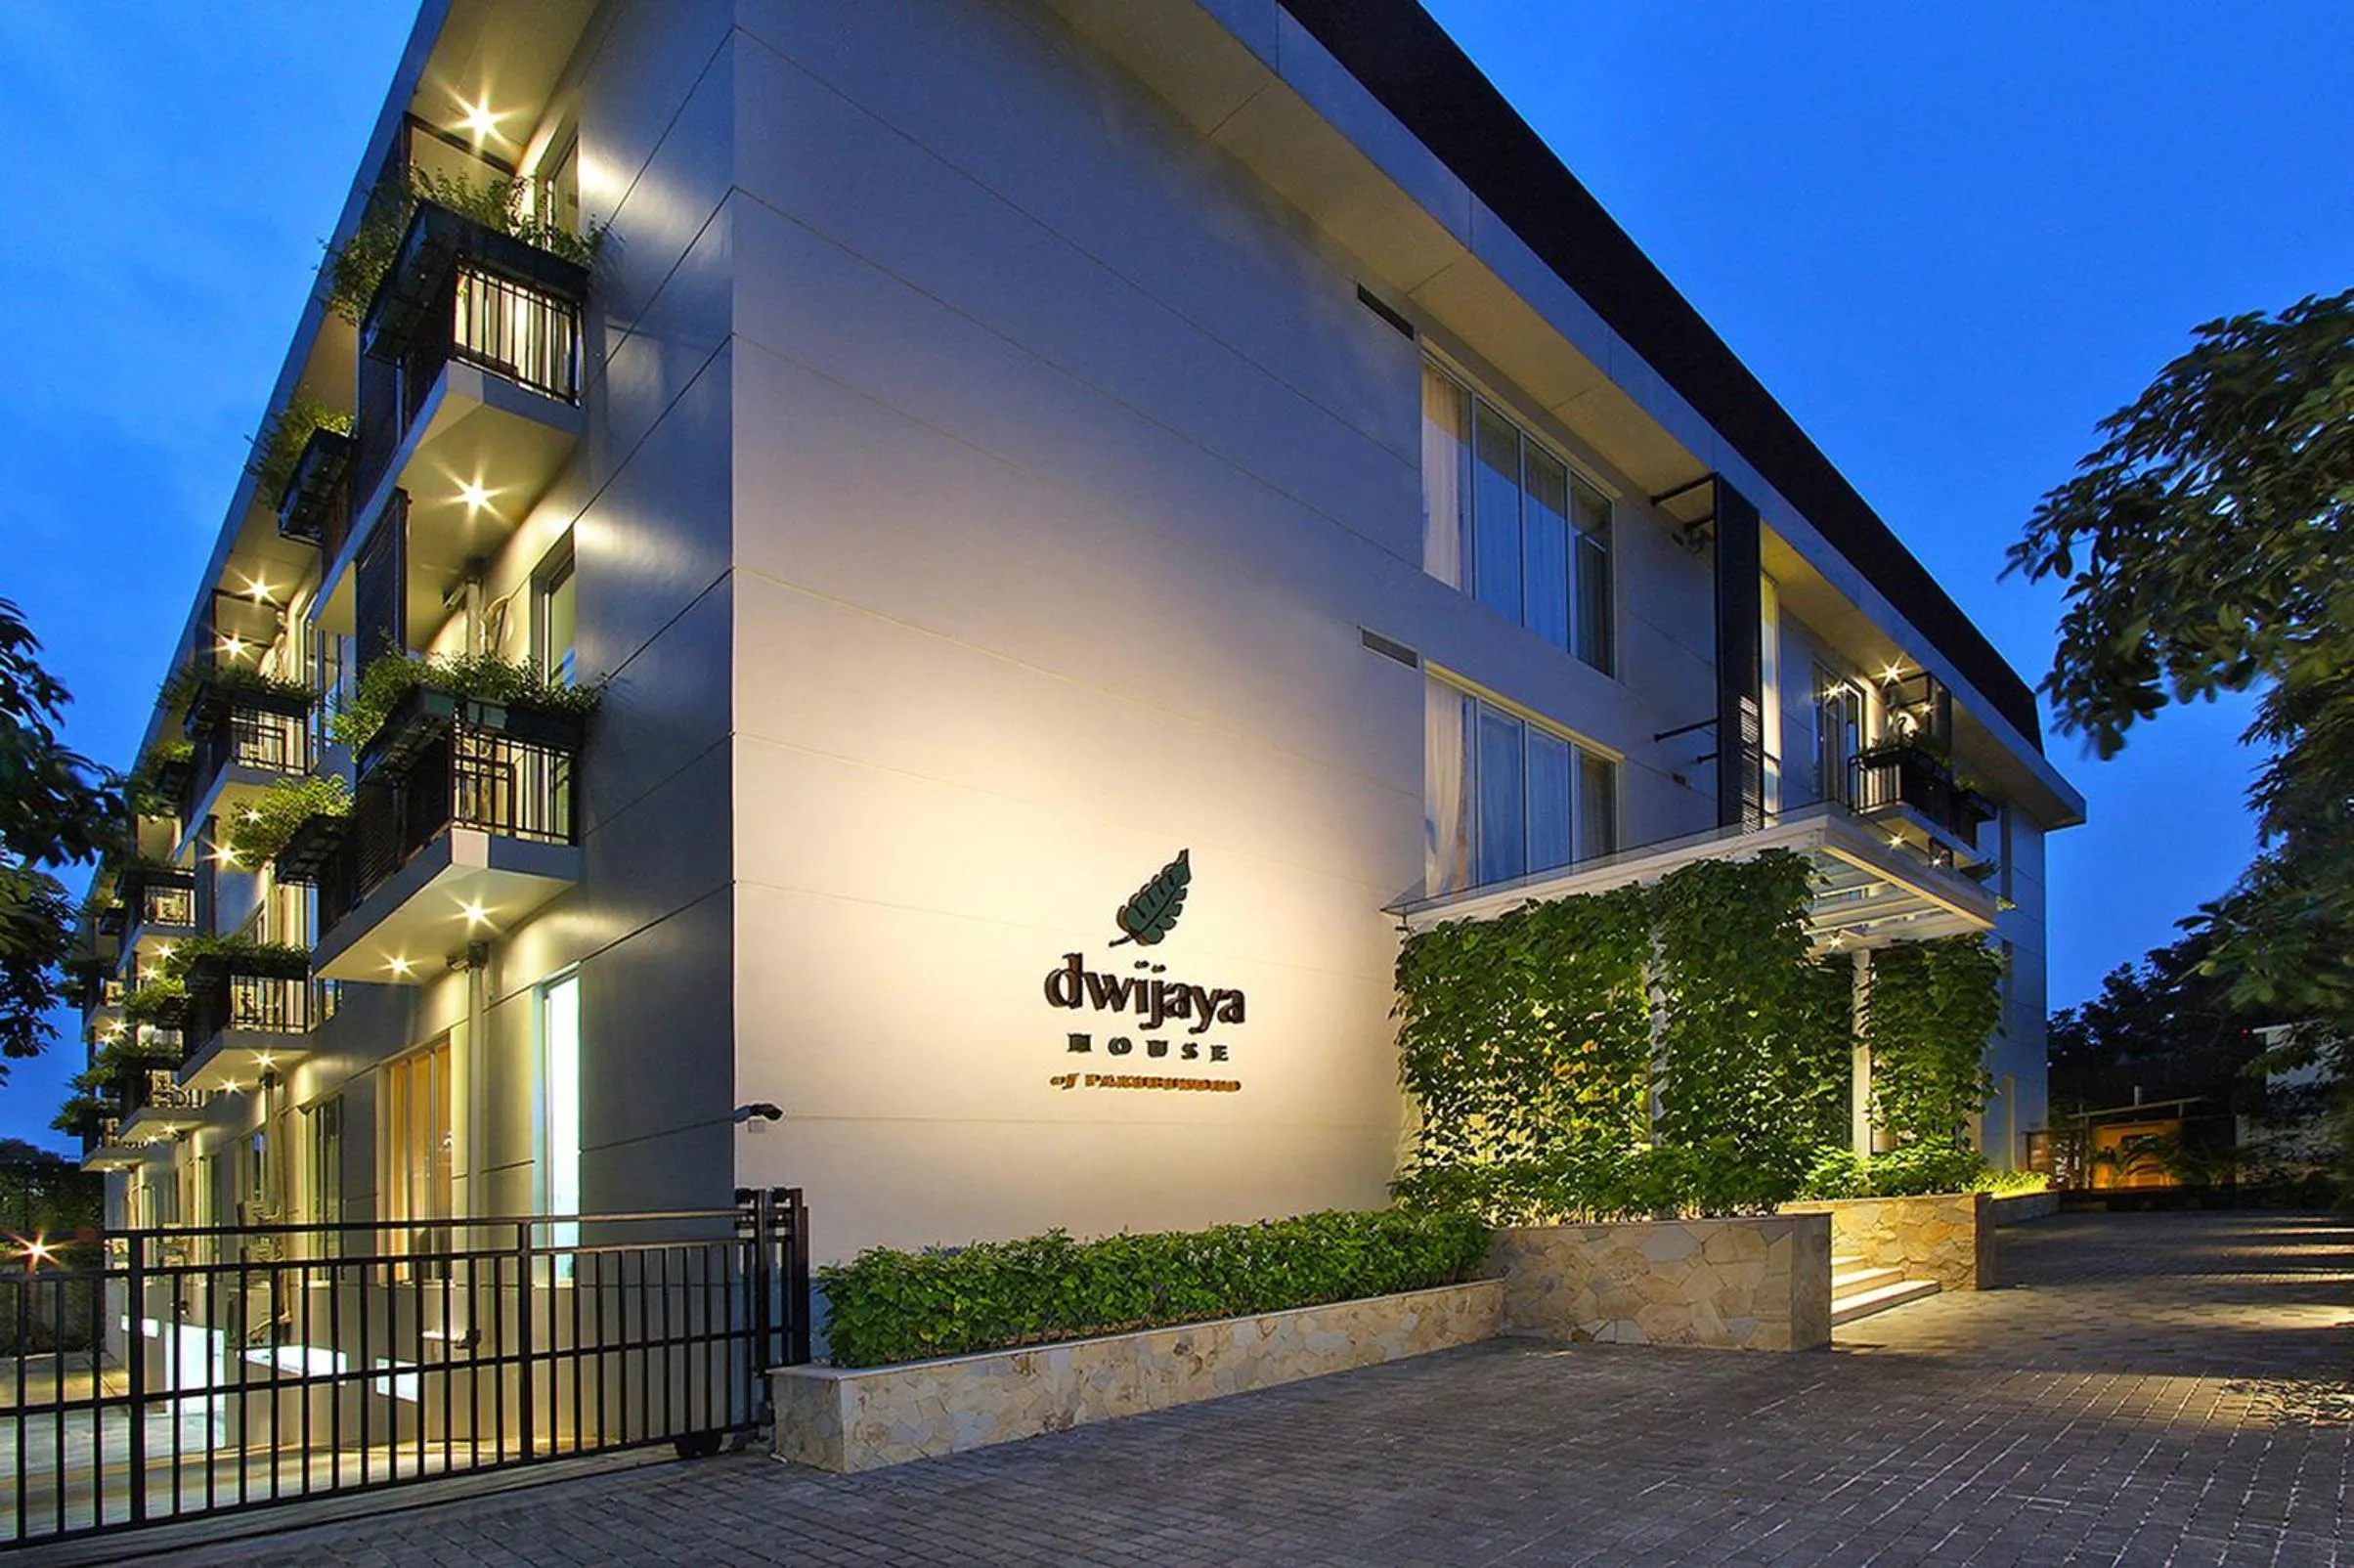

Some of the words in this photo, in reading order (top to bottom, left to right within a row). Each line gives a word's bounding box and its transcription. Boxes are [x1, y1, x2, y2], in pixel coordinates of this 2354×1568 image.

[1043, 951, 1245, 1035] dwijaya
[1067, 1032, 1230, 1063] HOUSE
[1049, 1072, 1080, 1091] of
